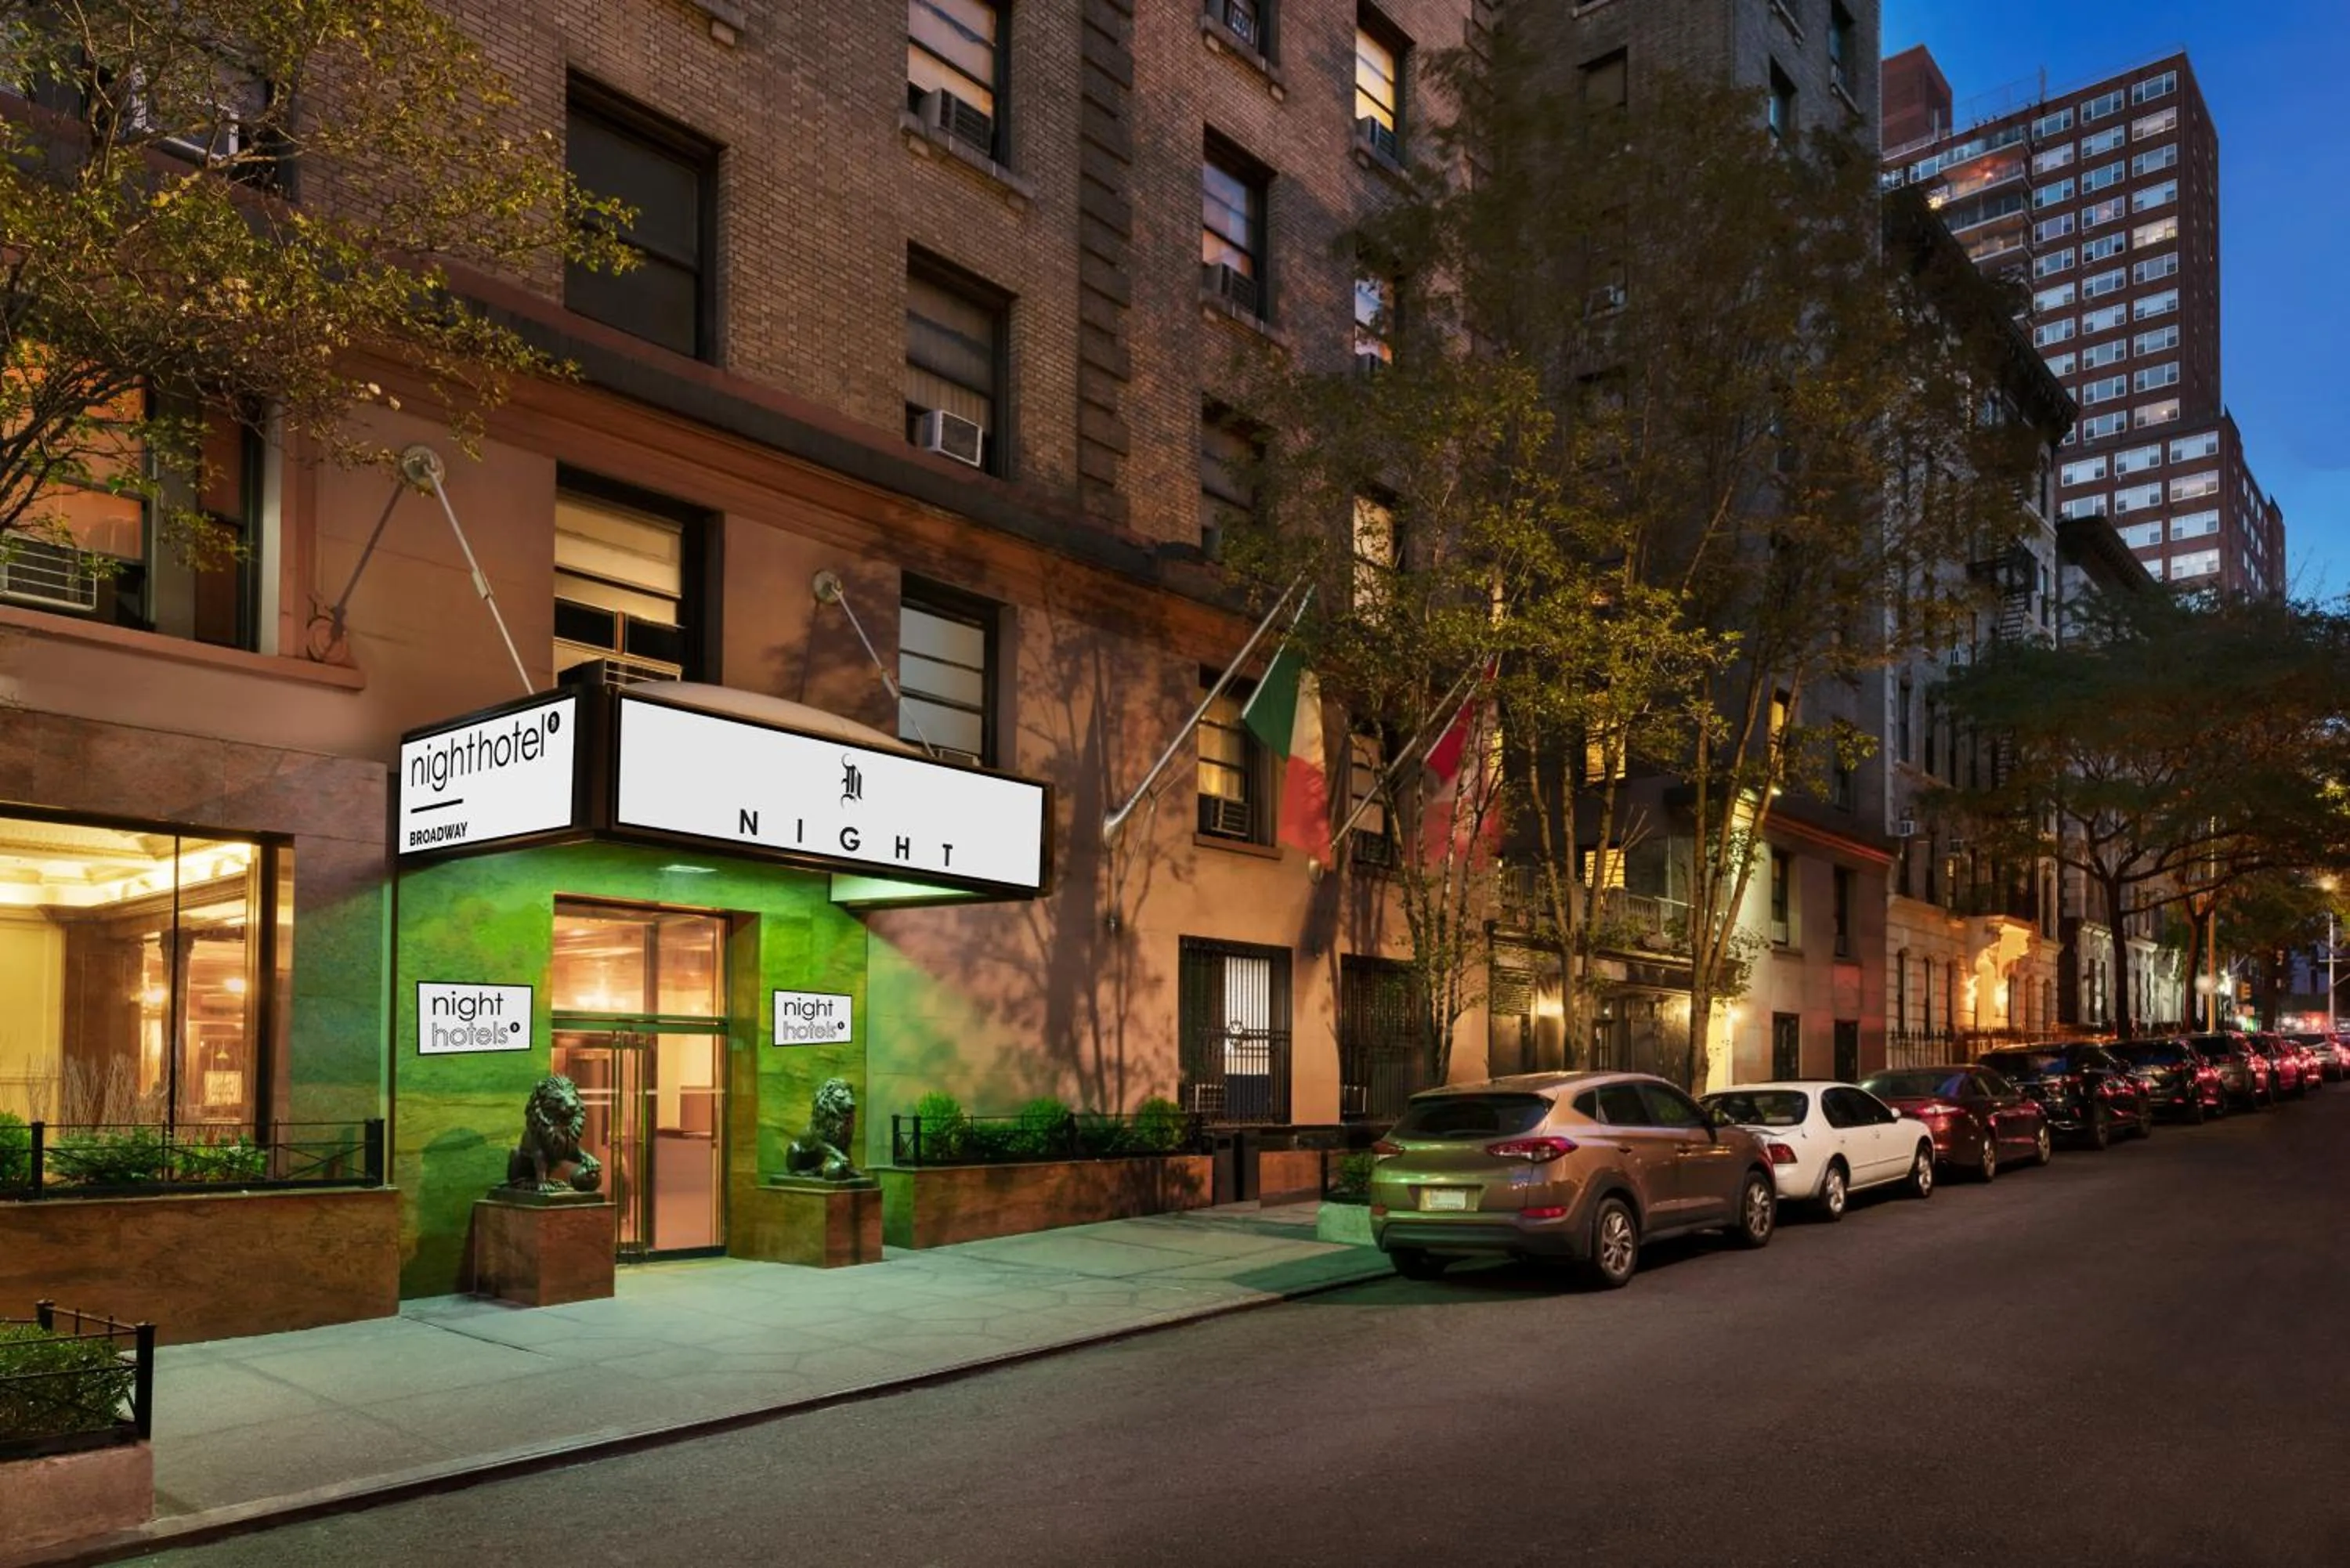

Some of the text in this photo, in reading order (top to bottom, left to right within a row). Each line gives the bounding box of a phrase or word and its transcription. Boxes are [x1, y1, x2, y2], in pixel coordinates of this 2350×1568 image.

[409, 822, 468, 847] BROADWAY
[739, 808, 953, 867] NIGHT
[432, 990, 504, 1021] night
[784, 997, 833, 1021] night
[431, 1021, 508, 1047] hotels
[783, 1021, 837, 1040] hotels
